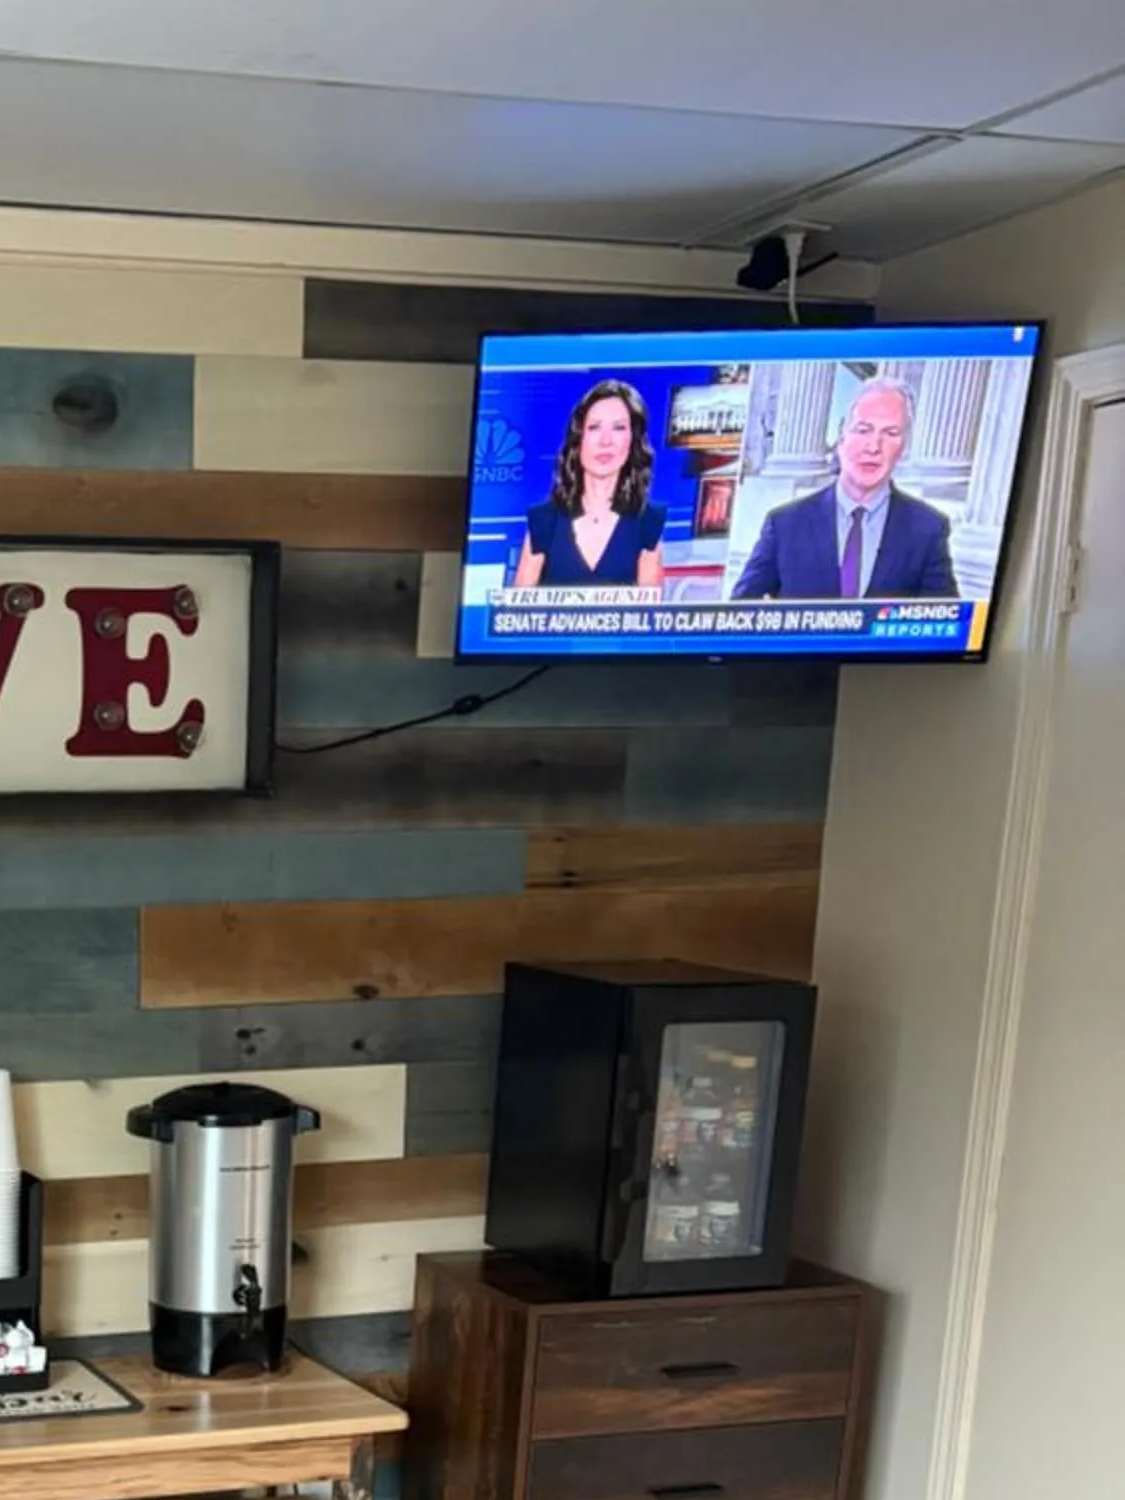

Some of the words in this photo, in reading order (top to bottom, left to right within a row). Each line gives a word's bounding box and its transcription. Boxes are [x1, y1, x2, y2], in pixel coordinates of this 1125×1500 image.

[494, 613, 546, 632] SENATE
[547, 613, 620, 632] ADVANCES
[622, 612, 652, 632] BILL
[654, 612, 674, 631] TO
[675, 611, 715, 631] CLAW
[716, 611, 753, 630] BACK
[755, 609, 783, 631] $9B
[783, 611, 801, 629] IN
[801, 610, 863, 629] FUNDING
[898, 605, 960, 619] MSNBC
